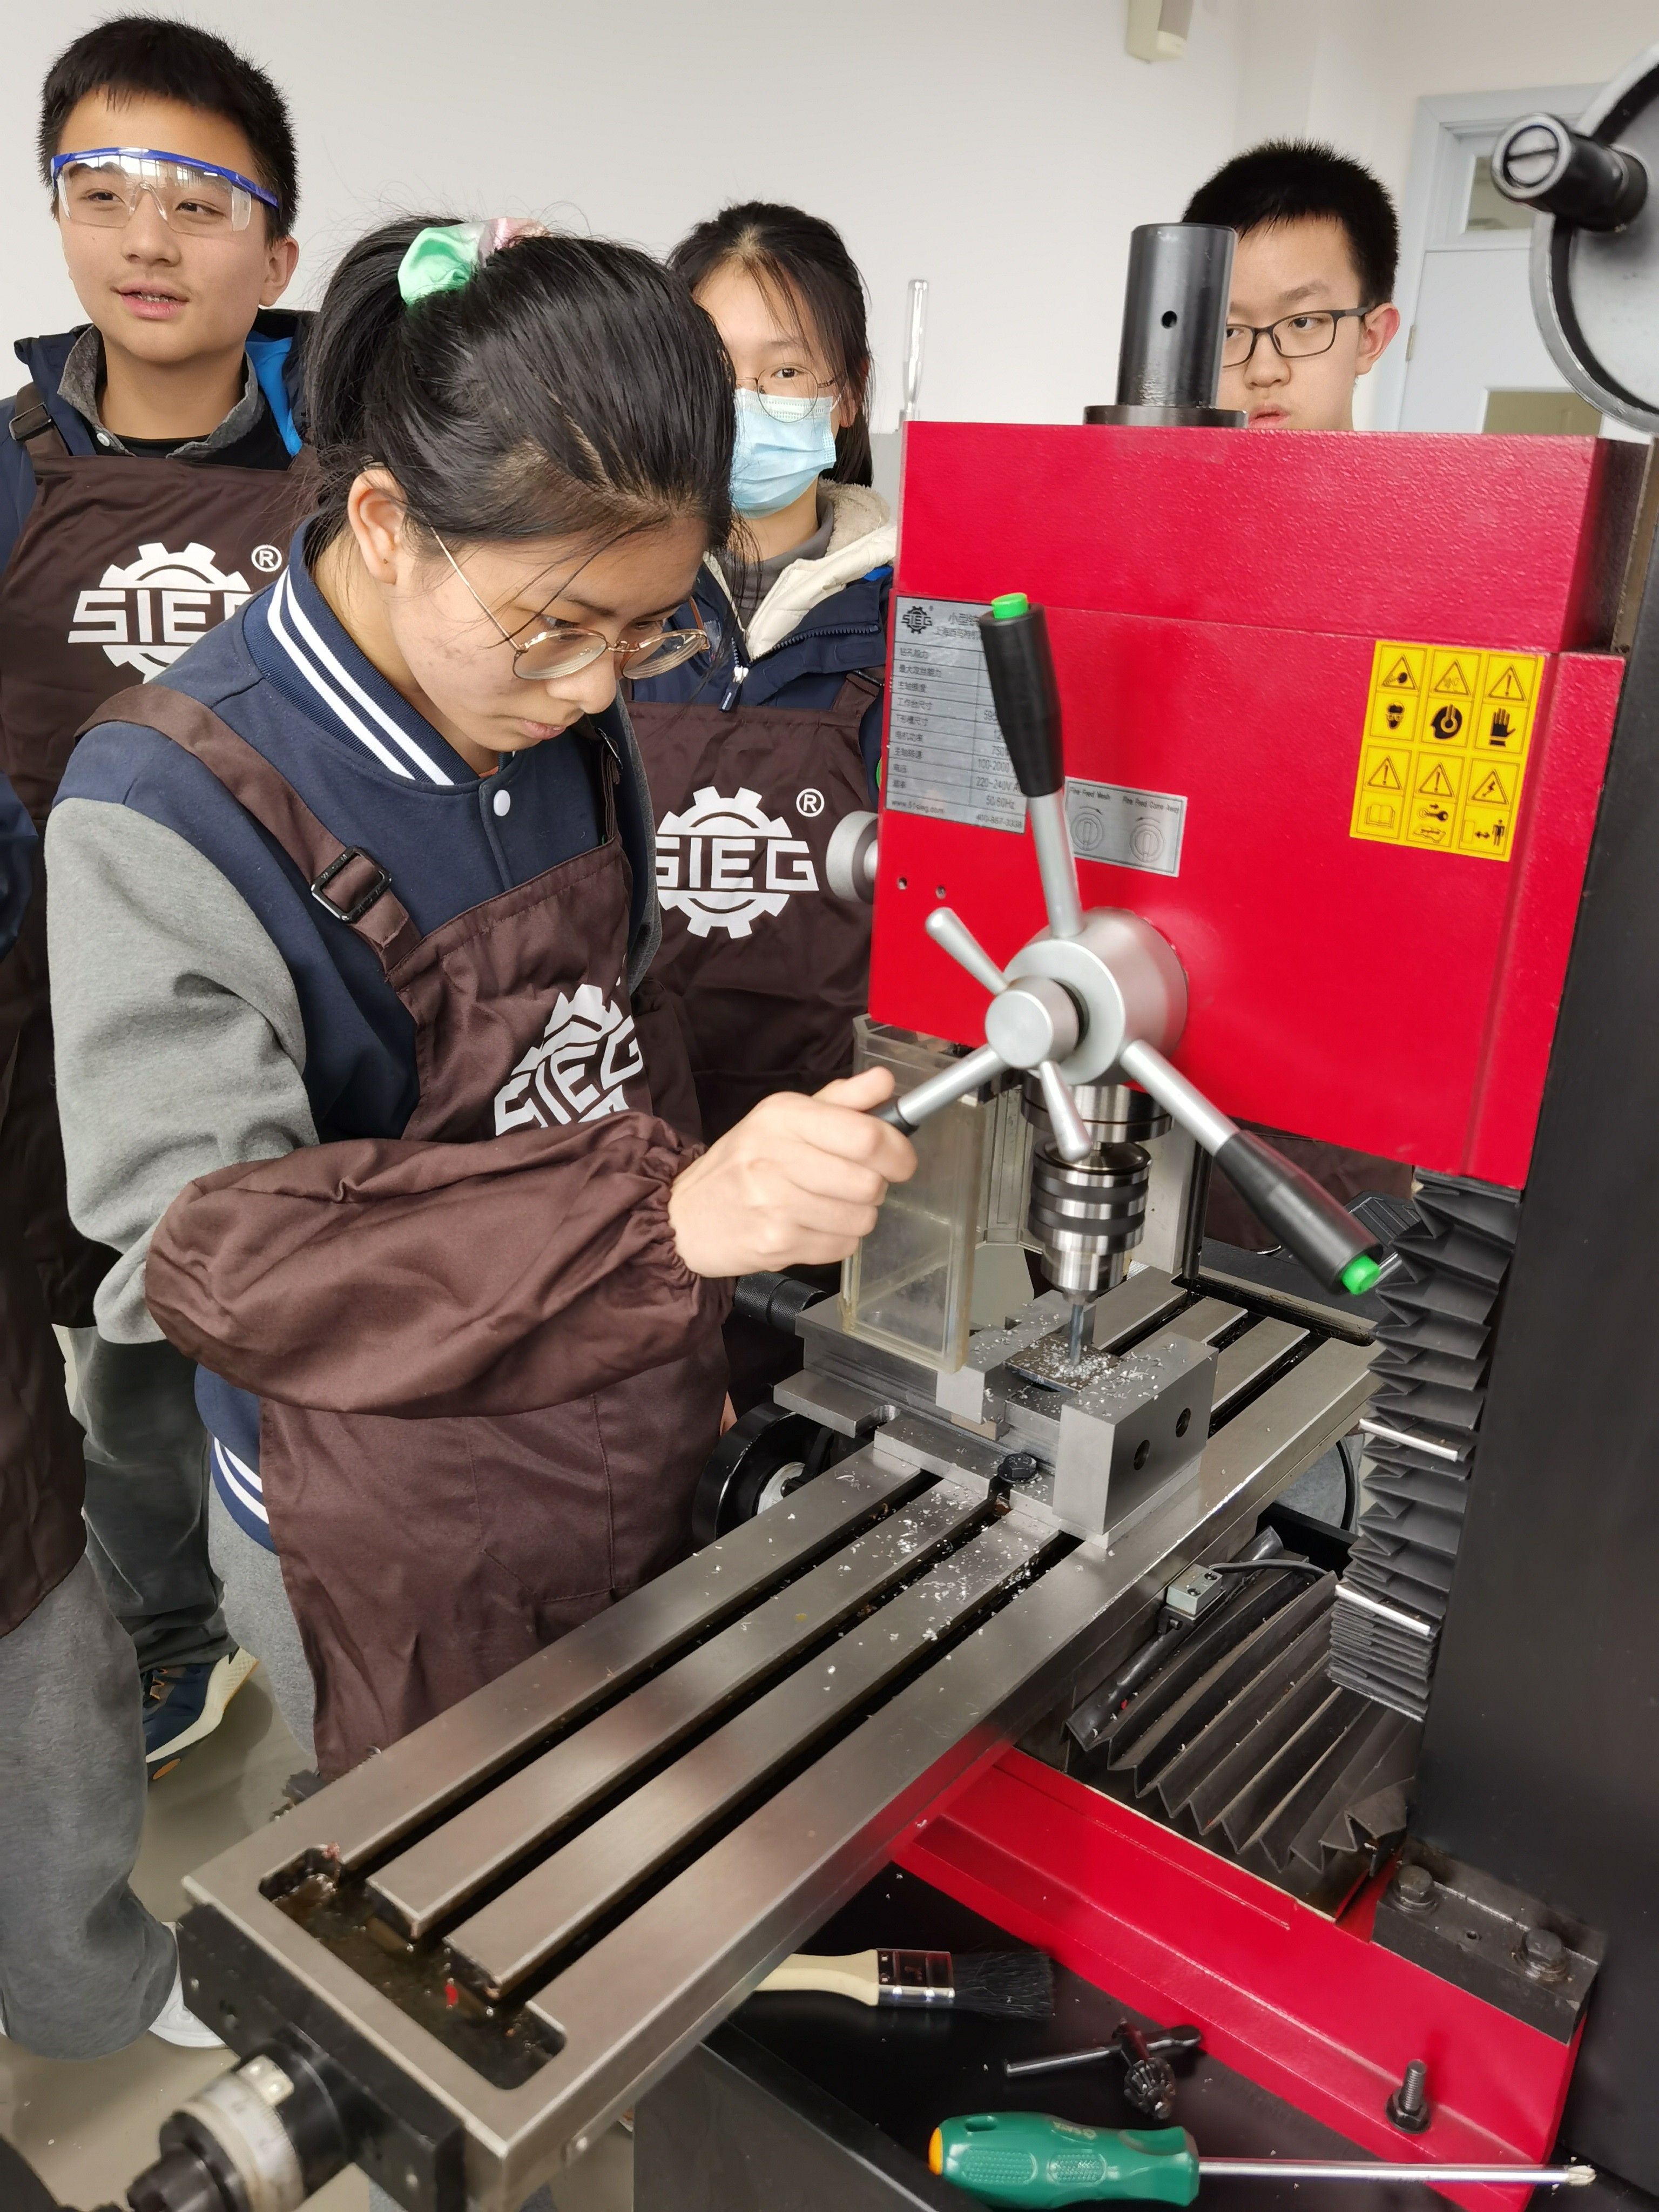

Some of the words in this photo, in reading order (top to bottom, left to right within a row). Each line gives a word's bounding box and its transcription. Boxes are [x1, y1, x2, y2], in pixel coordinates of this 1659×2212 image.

[901, 614, 933, 626] SIEG
[1082, 789, 1095, 798] Feed
[1135, 798, 1148, 808] Feed
[656, 836, 819, 891] SIEG
